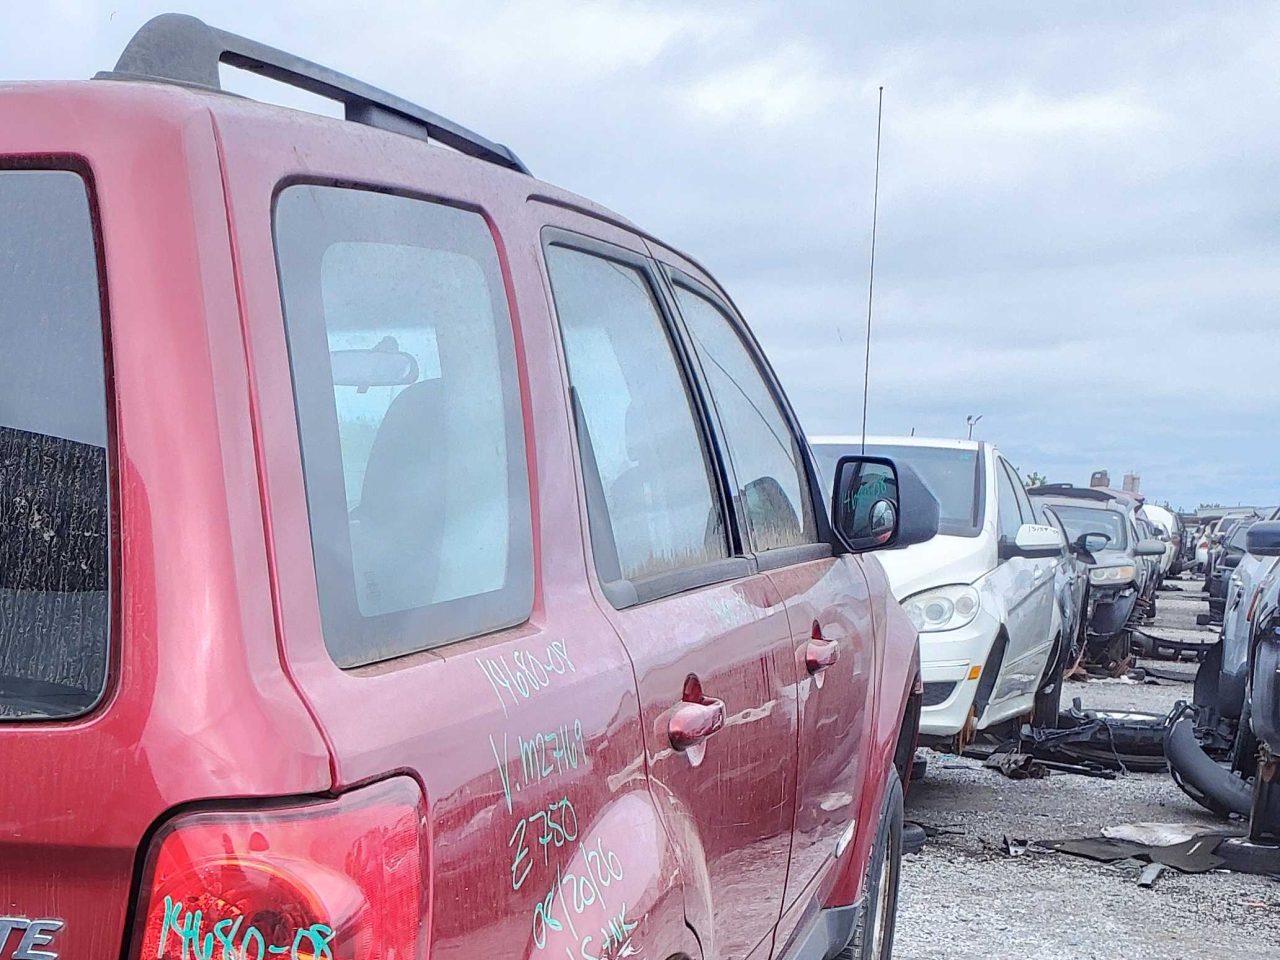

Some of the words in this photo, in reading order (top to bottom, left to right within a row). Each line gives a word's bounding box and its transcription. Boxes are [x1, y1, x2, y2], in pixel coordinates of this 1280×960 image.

[475, 637, 577, 719] 14680-08
[508, 796, 579, 891] Z750
[532, 836, 624, 950] 08/20/26
